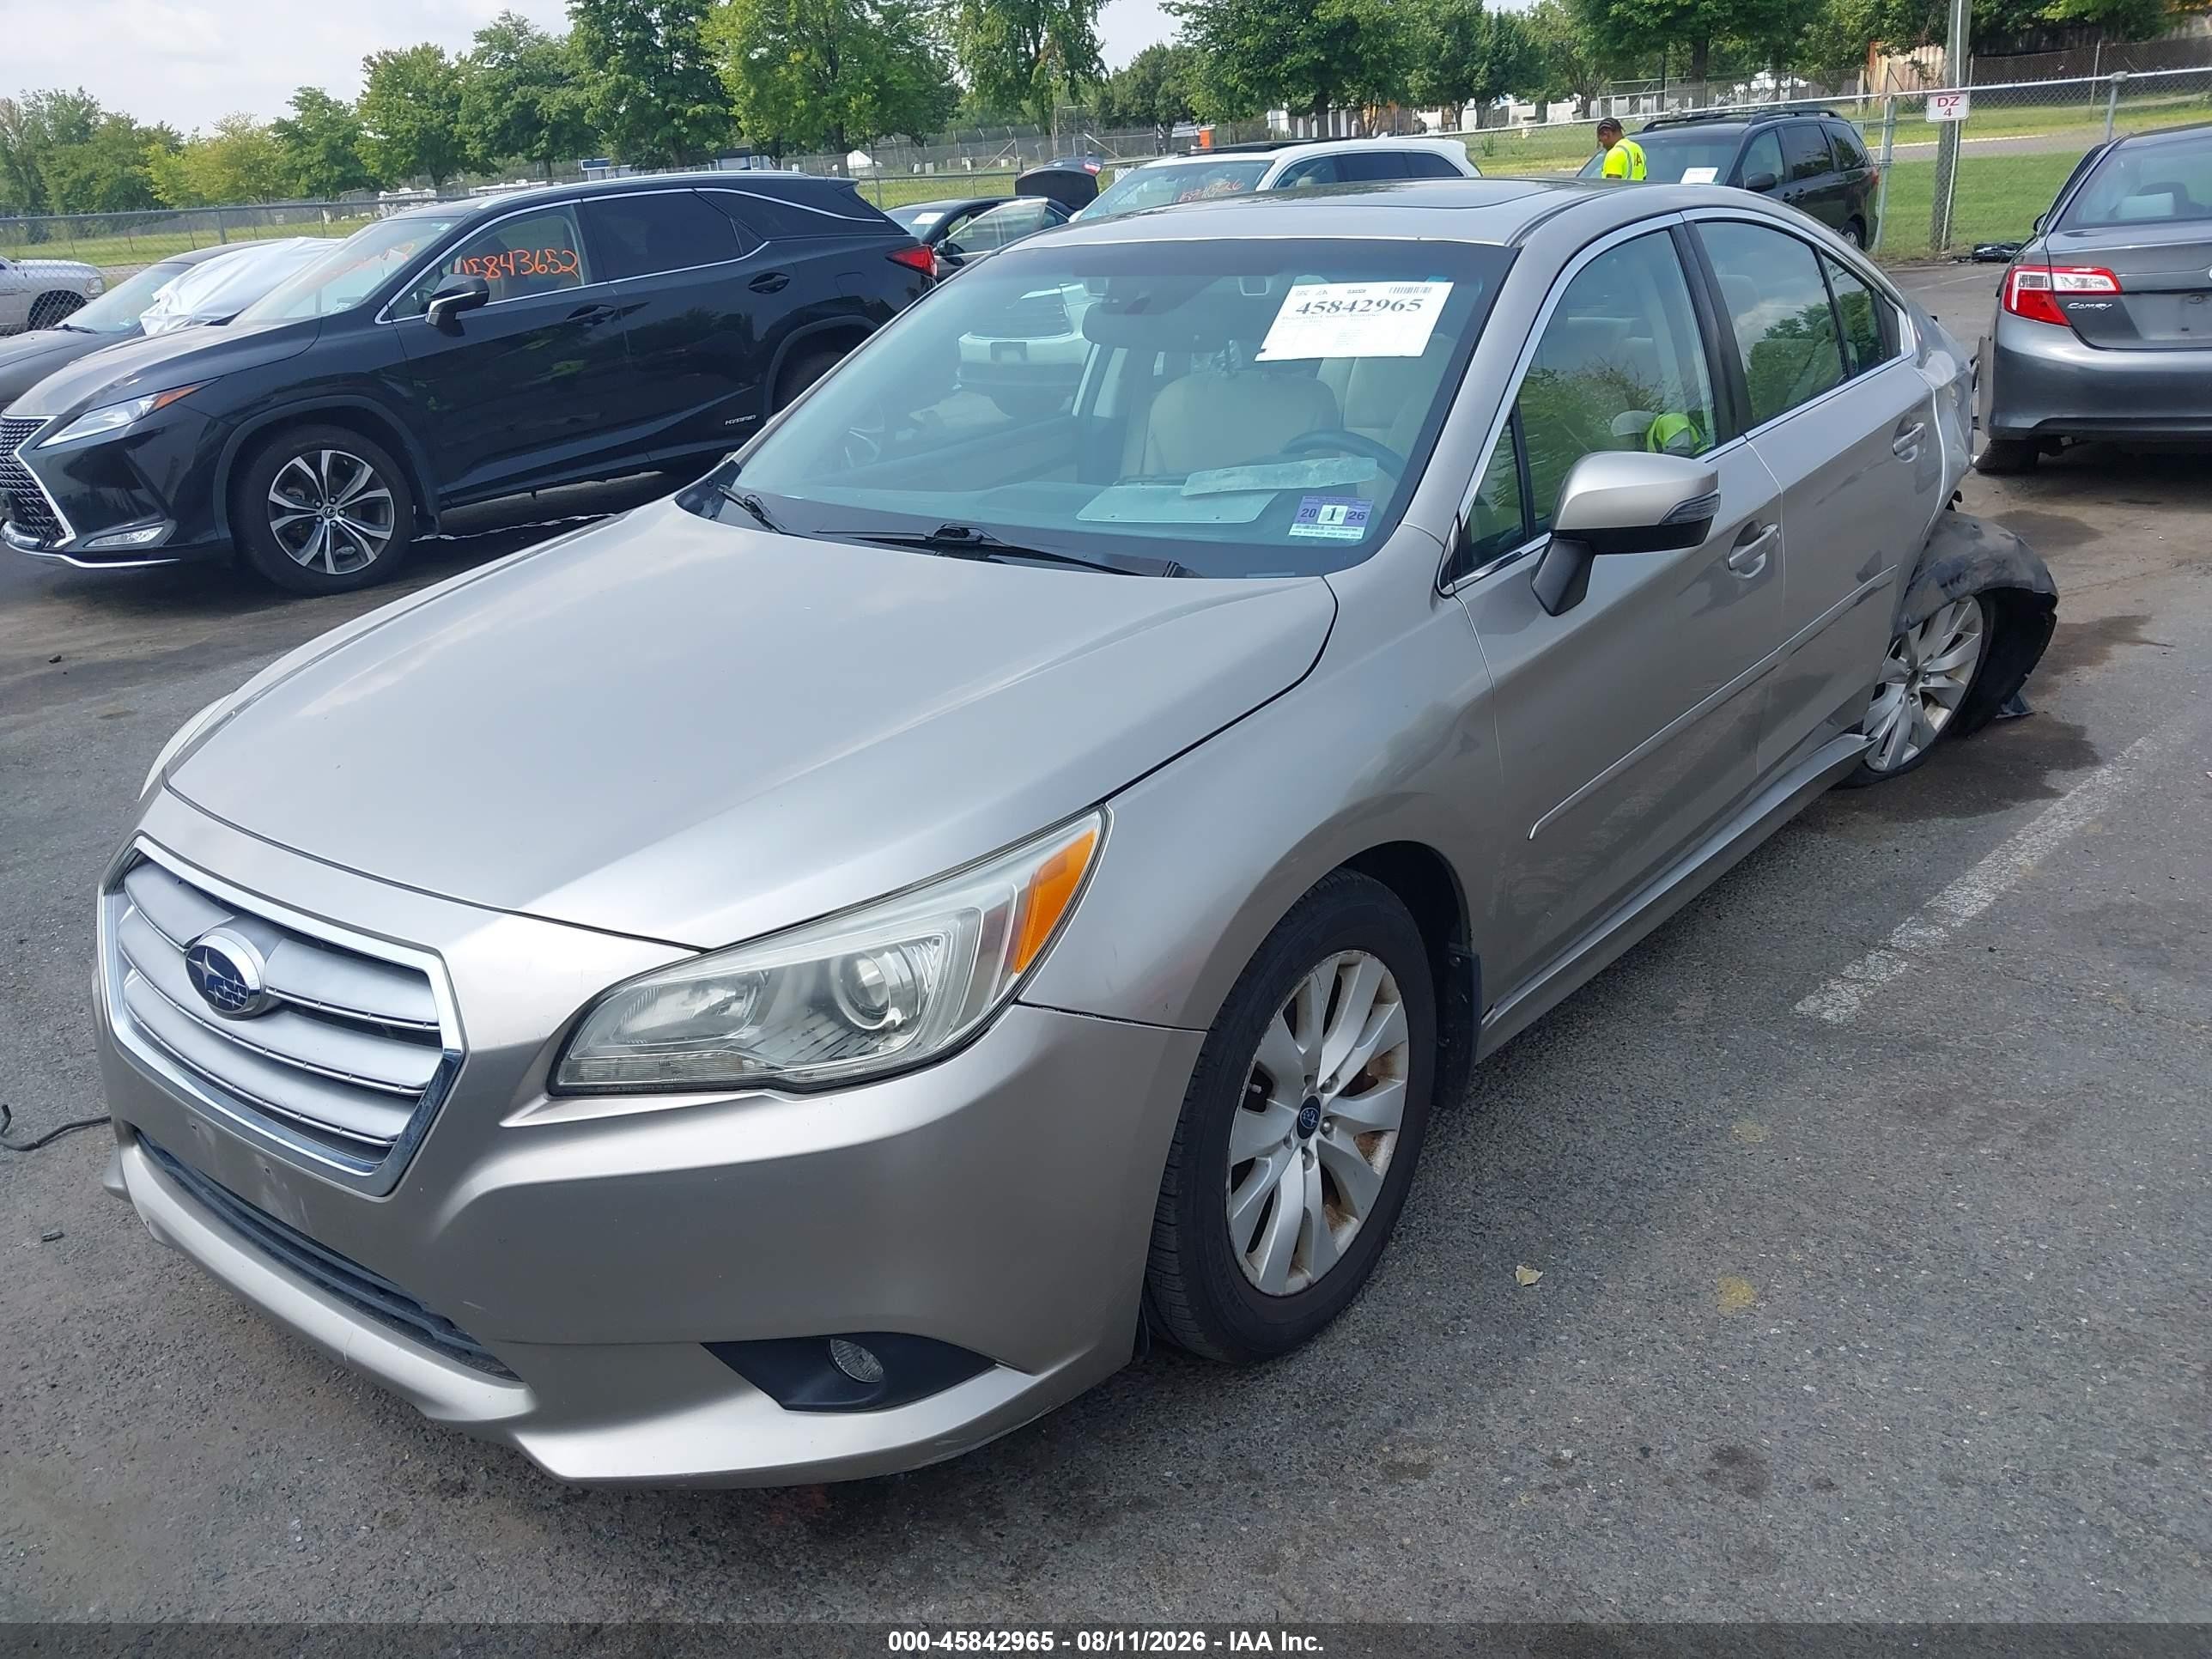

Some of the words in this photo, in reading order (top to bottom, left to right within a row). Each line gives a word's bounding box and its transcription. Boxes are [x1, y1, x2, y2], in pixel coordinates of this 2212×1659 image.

[1937, 96, 1960, 107] DZ
[1943, 108, 1952, 117] 4
[1295, 298, 1425, 315] 45842965
[1300, 508, 1316, 518] 20
[1327, 507, 1338, 521] 1
[1347, 511, 1366, 520] 26
